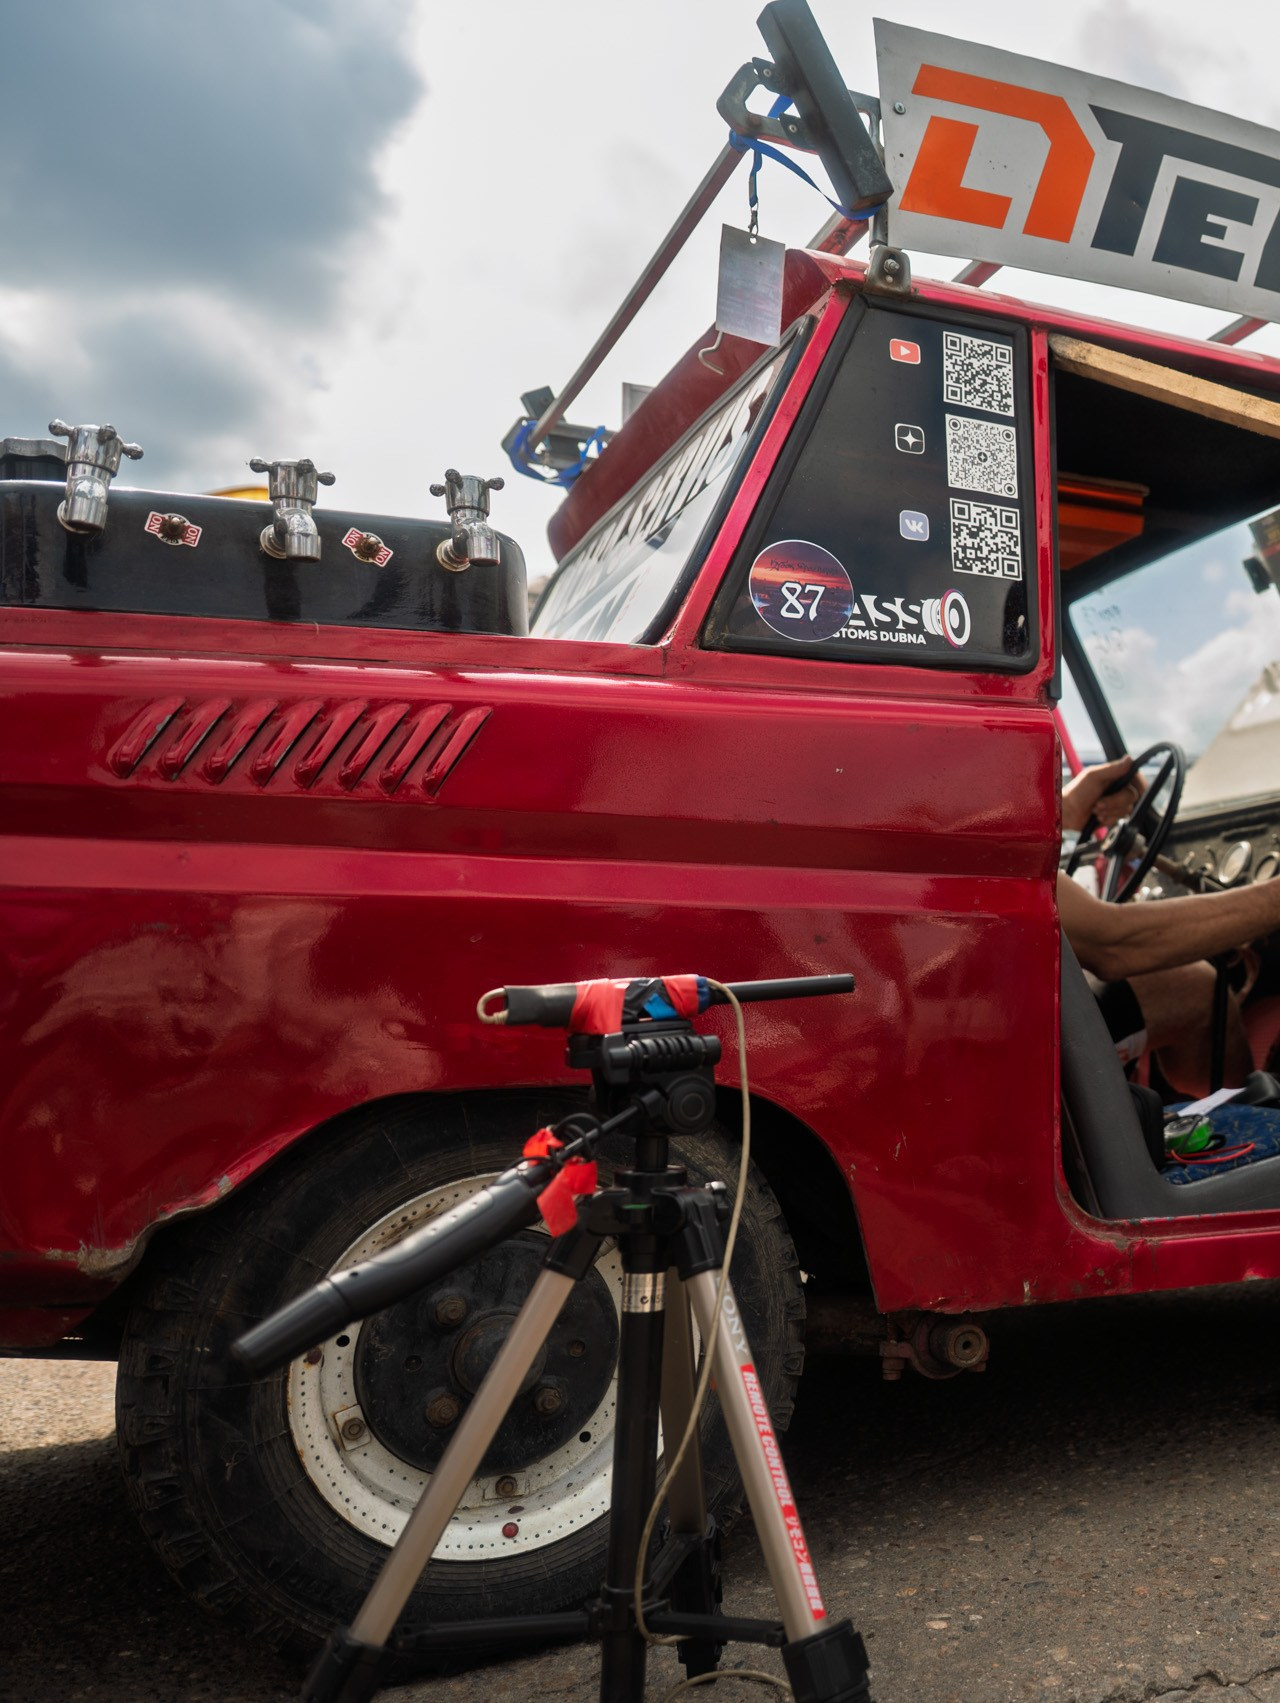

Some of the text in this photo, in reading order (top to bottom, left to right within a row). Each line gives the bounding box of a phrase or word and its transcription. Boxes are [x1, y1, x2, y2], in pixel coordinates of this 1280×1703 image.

[148, 514, 163, 533] ON
[184, 527, 199, 545] ON
[346, 530, 361, 546] ON
[375, 548, 390, 564] ON
[779, 581, 826, 622] 87
[832, 627, 927, 645] STOMS DUBNA
[743, 1370, 793, 1507] REMOTE CONTROL
